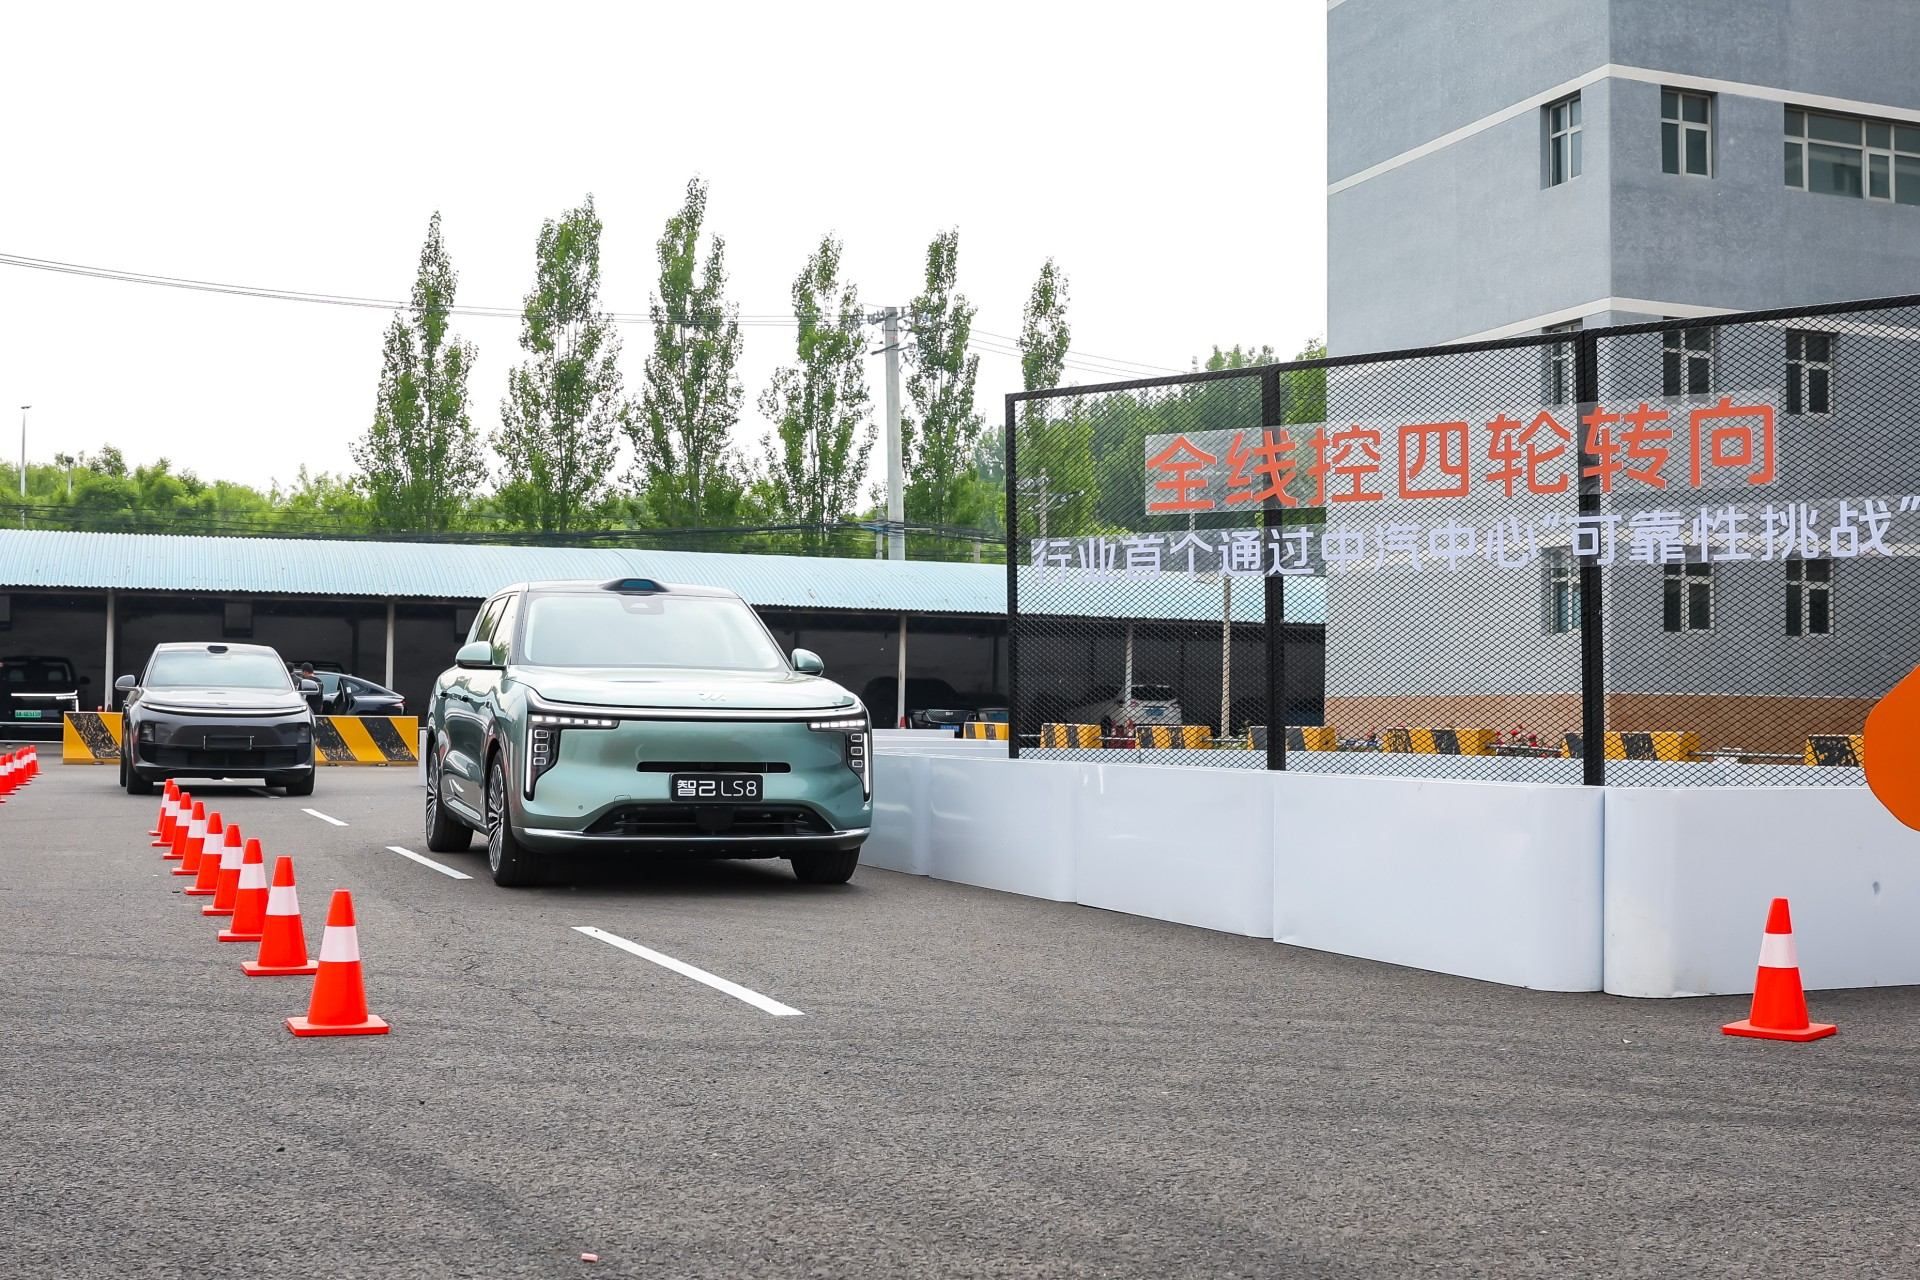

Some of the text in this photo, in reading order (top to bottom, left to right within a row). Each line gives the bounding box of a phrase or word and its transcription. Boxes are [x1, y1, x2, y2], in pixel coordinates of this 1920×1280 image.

[1145, 396, 1776, 512] 全线控四轮转向
[677, 779, 757, 797] 智己 LS8
